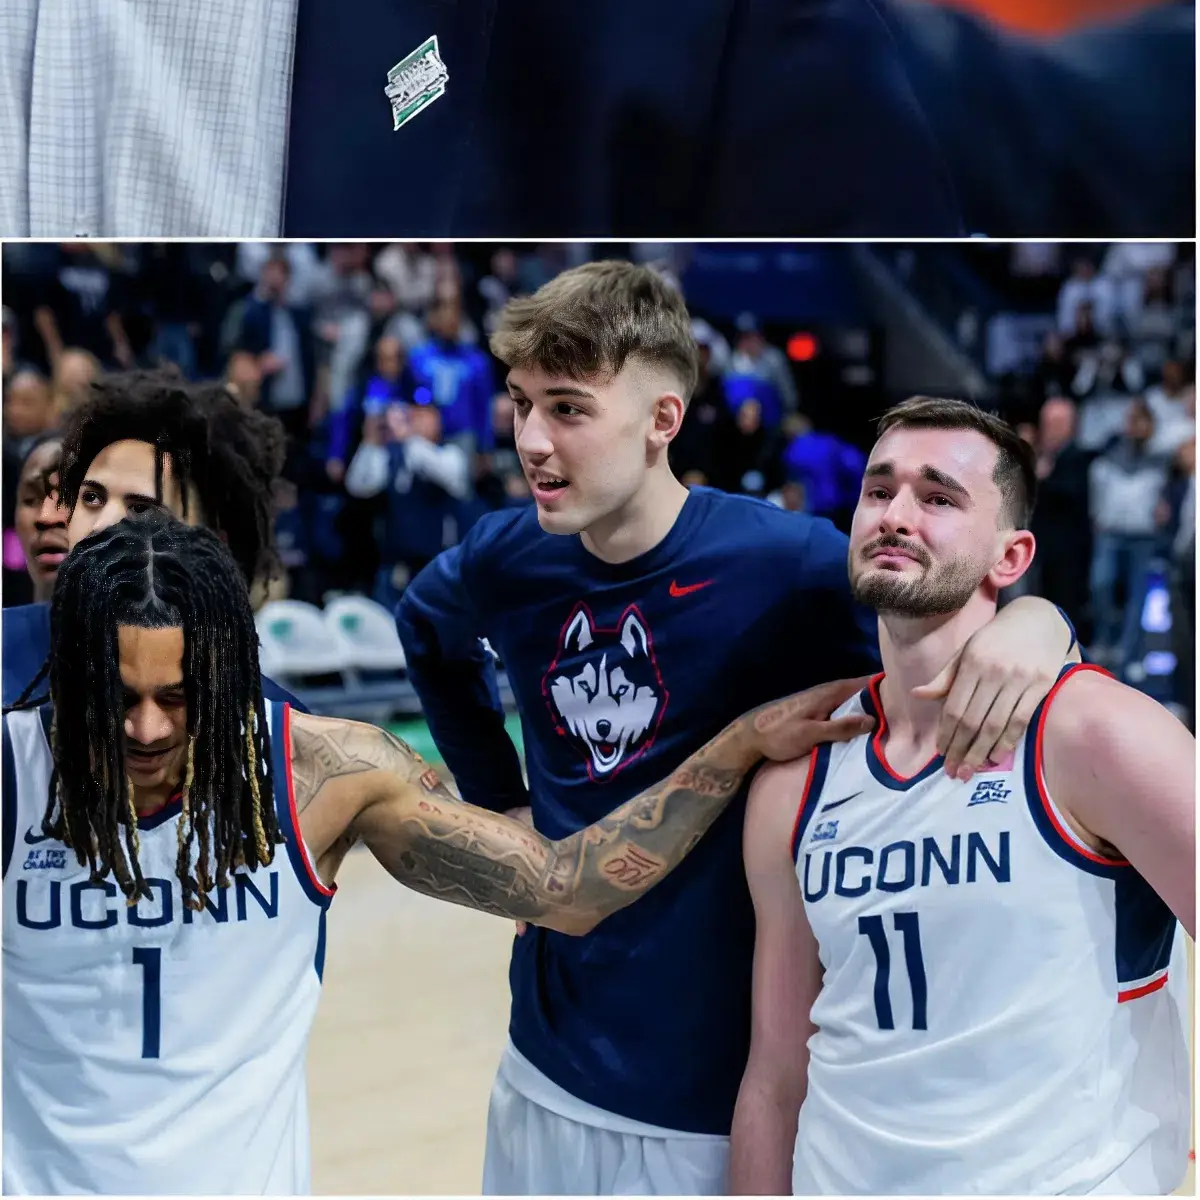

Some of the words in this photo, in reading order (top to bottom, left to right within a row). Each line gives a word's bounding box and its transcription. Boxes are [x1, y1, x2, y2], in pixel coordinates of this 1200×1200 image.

[16, 871, 279, 930] UCONN
[803, 831, 1011, 903] UCONN
[132, 947, 162, 1059] 1
[858, 911, 928, 1031] 11
